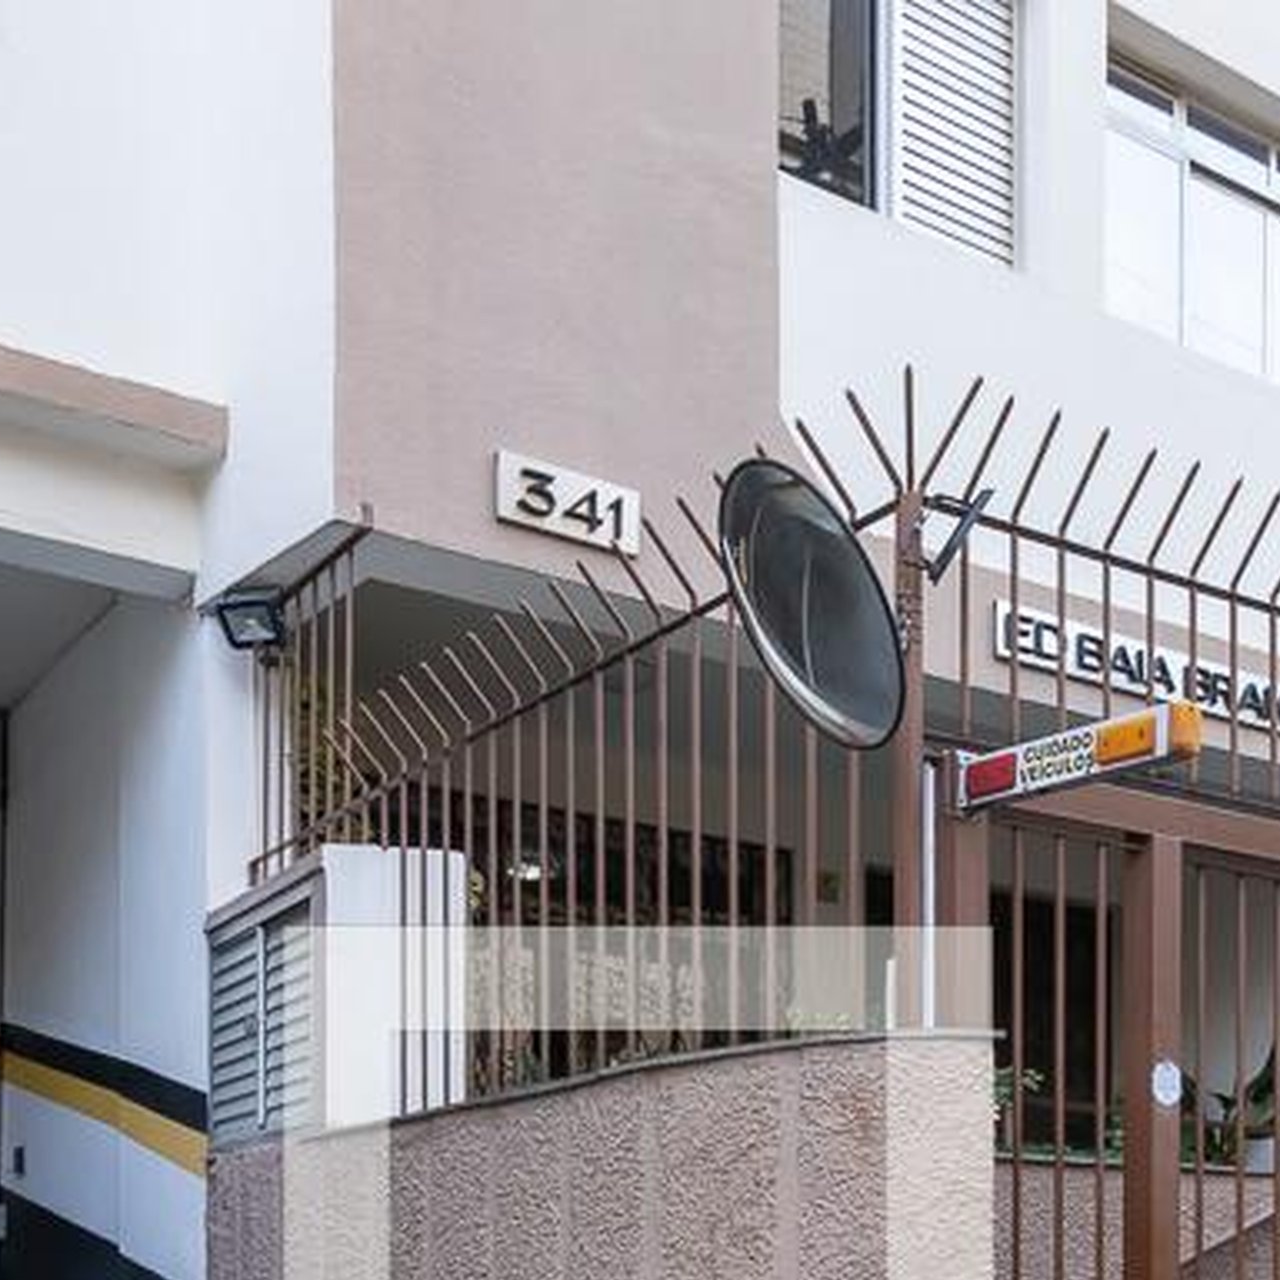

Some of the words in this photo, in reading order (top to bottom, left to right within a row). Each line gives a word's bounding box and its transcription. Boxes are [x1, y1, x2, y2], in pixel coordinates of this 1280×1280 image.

[516, 468, 623, 540] 341
[1076, 632, 1175, 694] BAIA
[1023, 731, 1093, 763] CUIDADO
